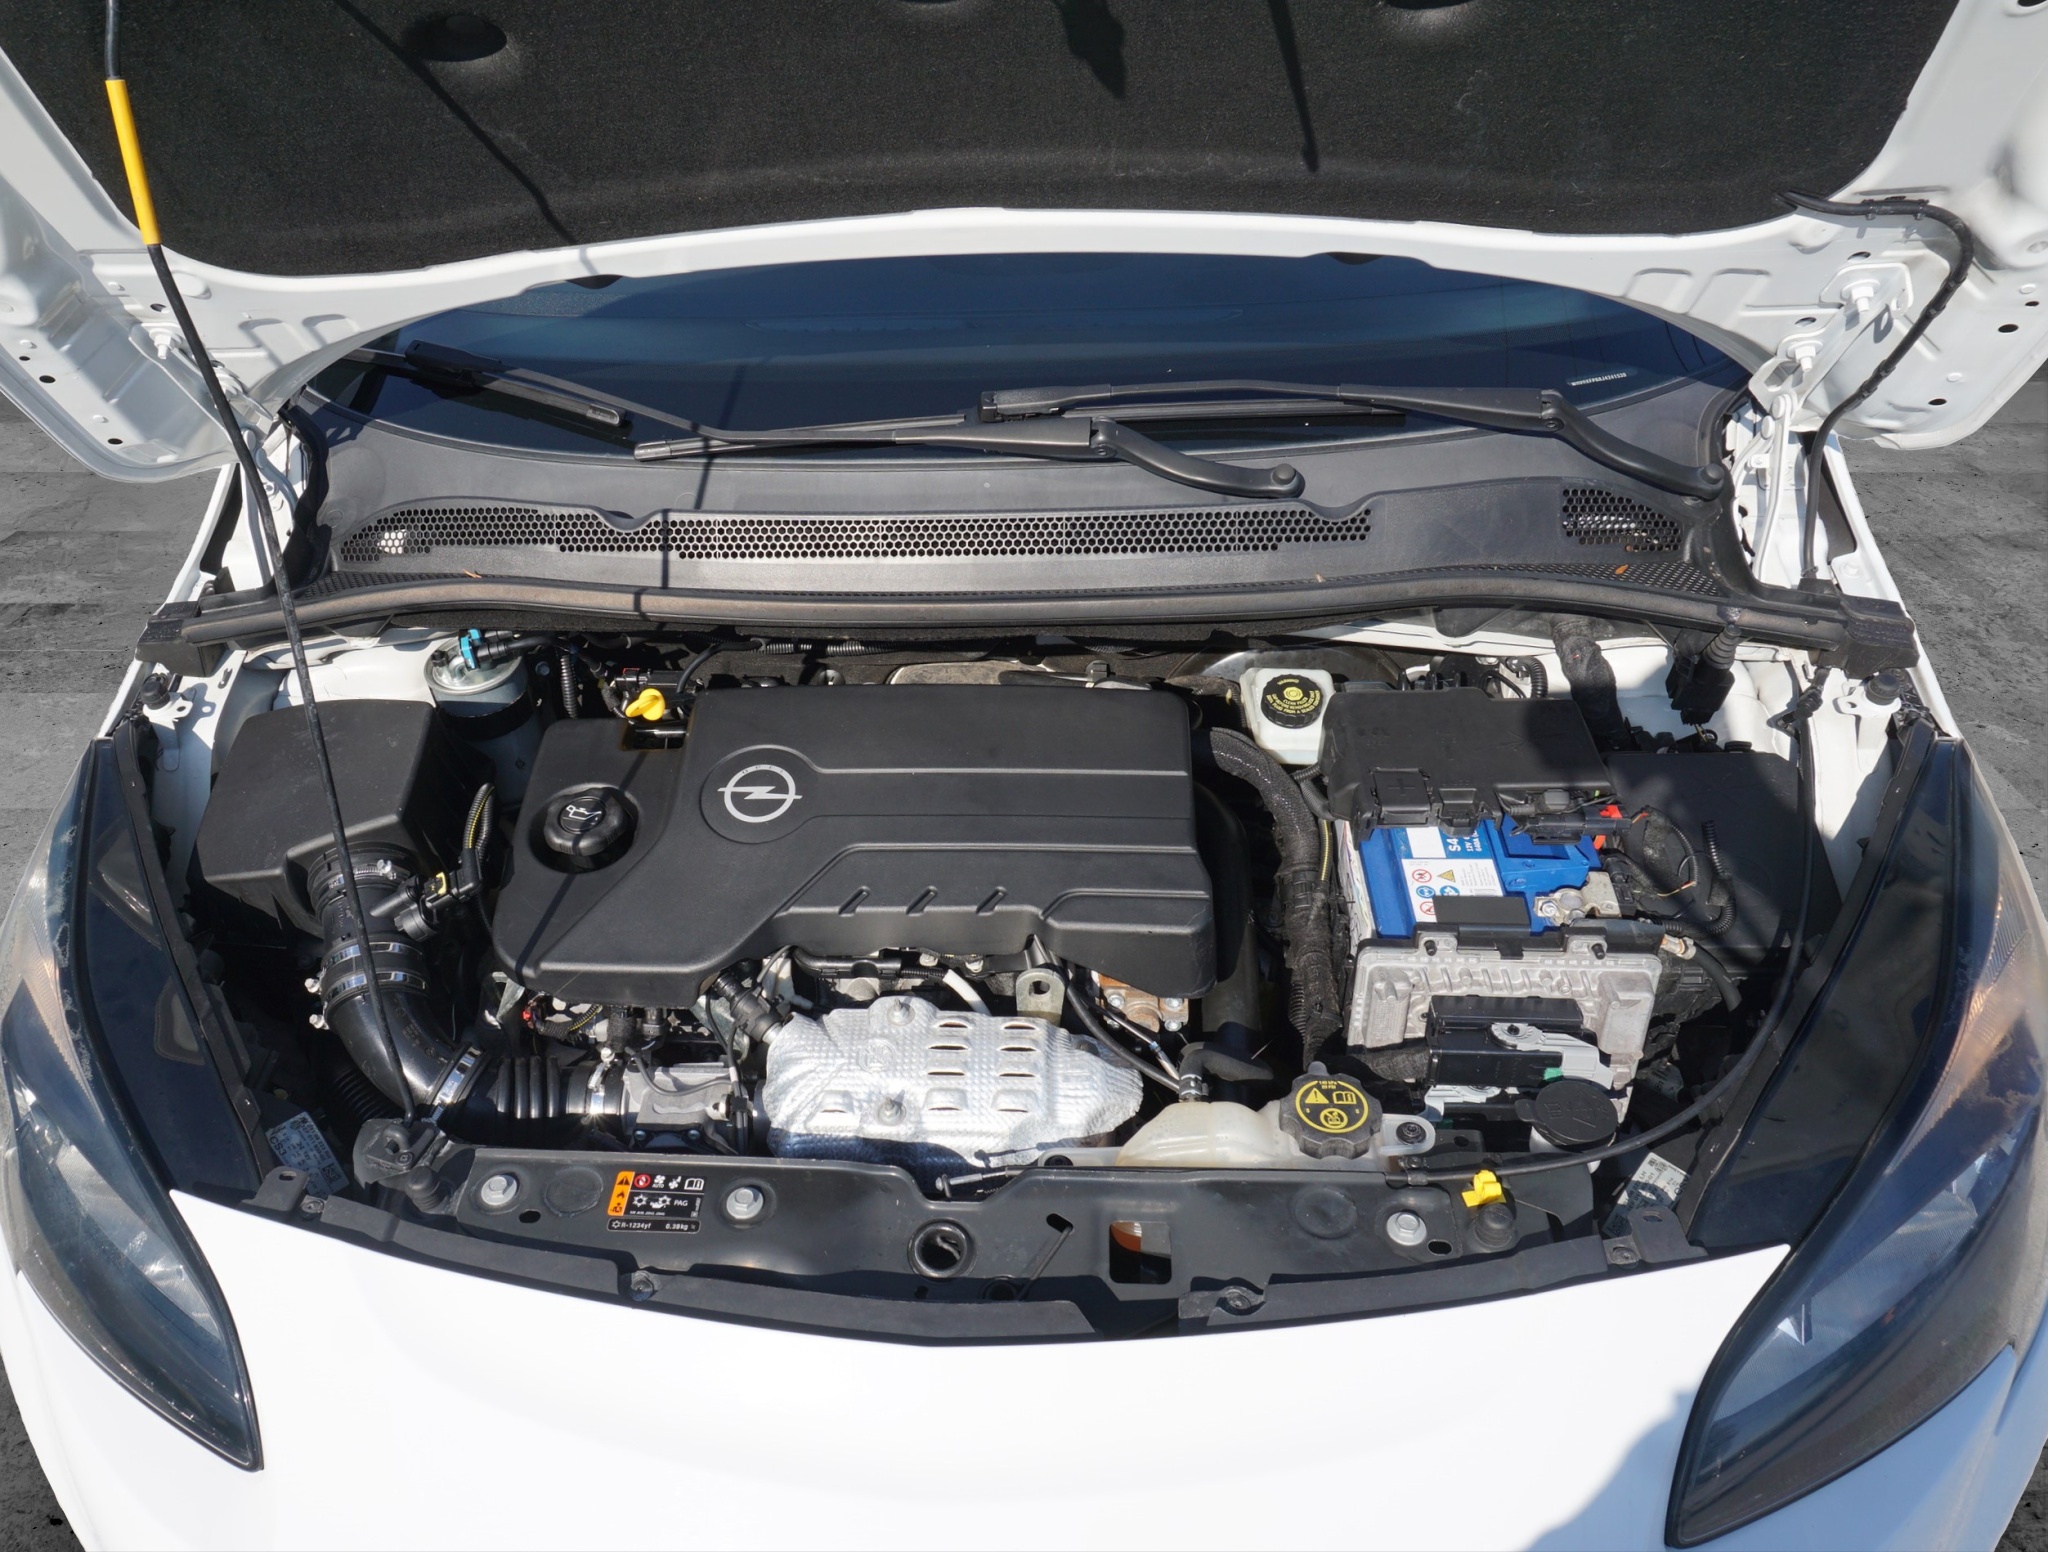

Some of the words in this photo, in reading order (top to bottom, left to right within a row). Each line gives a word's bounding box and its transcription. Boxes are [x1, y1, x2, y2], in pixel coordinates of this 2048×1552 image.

[1446, 838, 1461, 852] S4
[269, 1136, 287, 1156] CS3
[673, 1199, 688, 1207] PAG
[620, 1222, 652, 1230] R-1234yf
